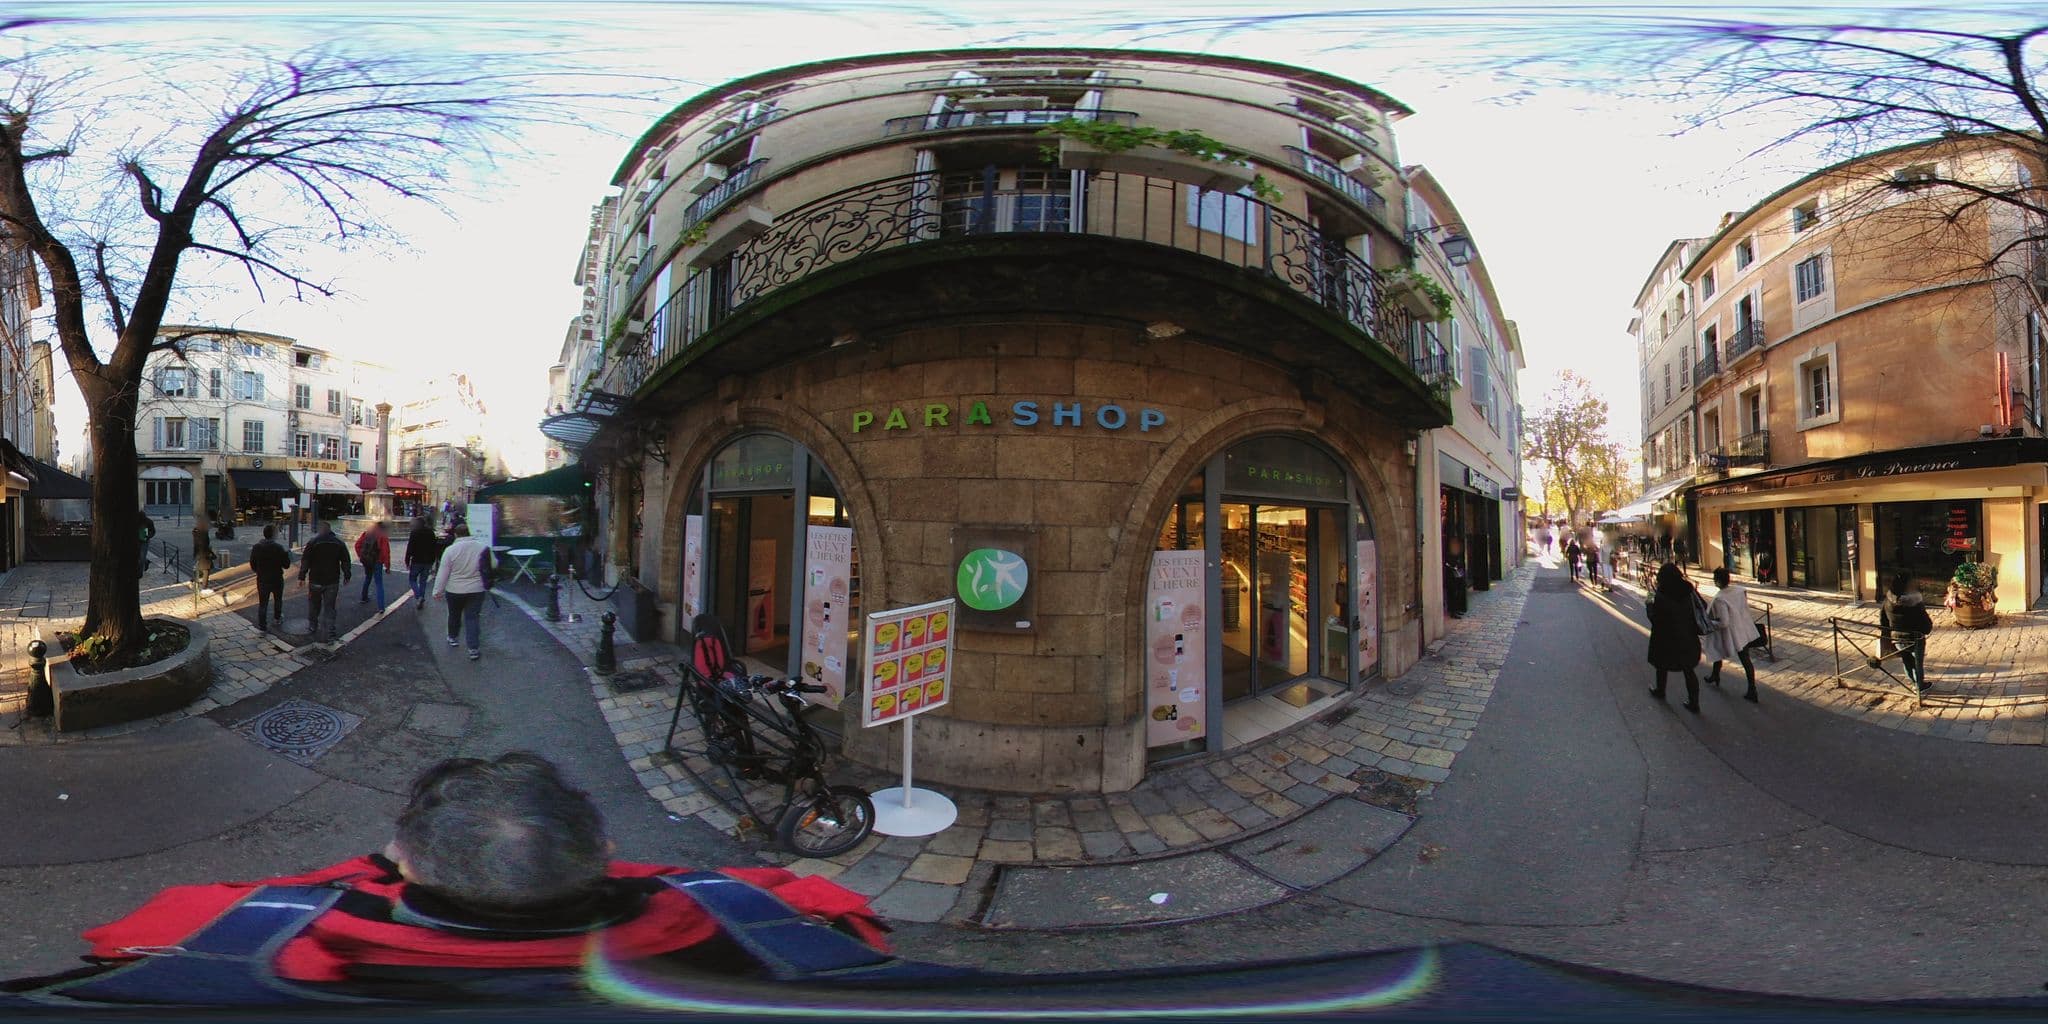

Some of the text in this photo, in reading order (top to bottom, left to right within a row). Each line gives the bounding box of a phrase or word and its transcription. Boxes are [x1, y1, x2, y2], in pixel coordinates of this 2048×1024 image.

[852, 401, 1166, 433] PARASHOP
[1857, 461, 1960, 479] Le Provence
[810, 531, 824, 539] LES
[811, 540, 848, 553] AVENT
[1152, 558, 1170, 567] LES
